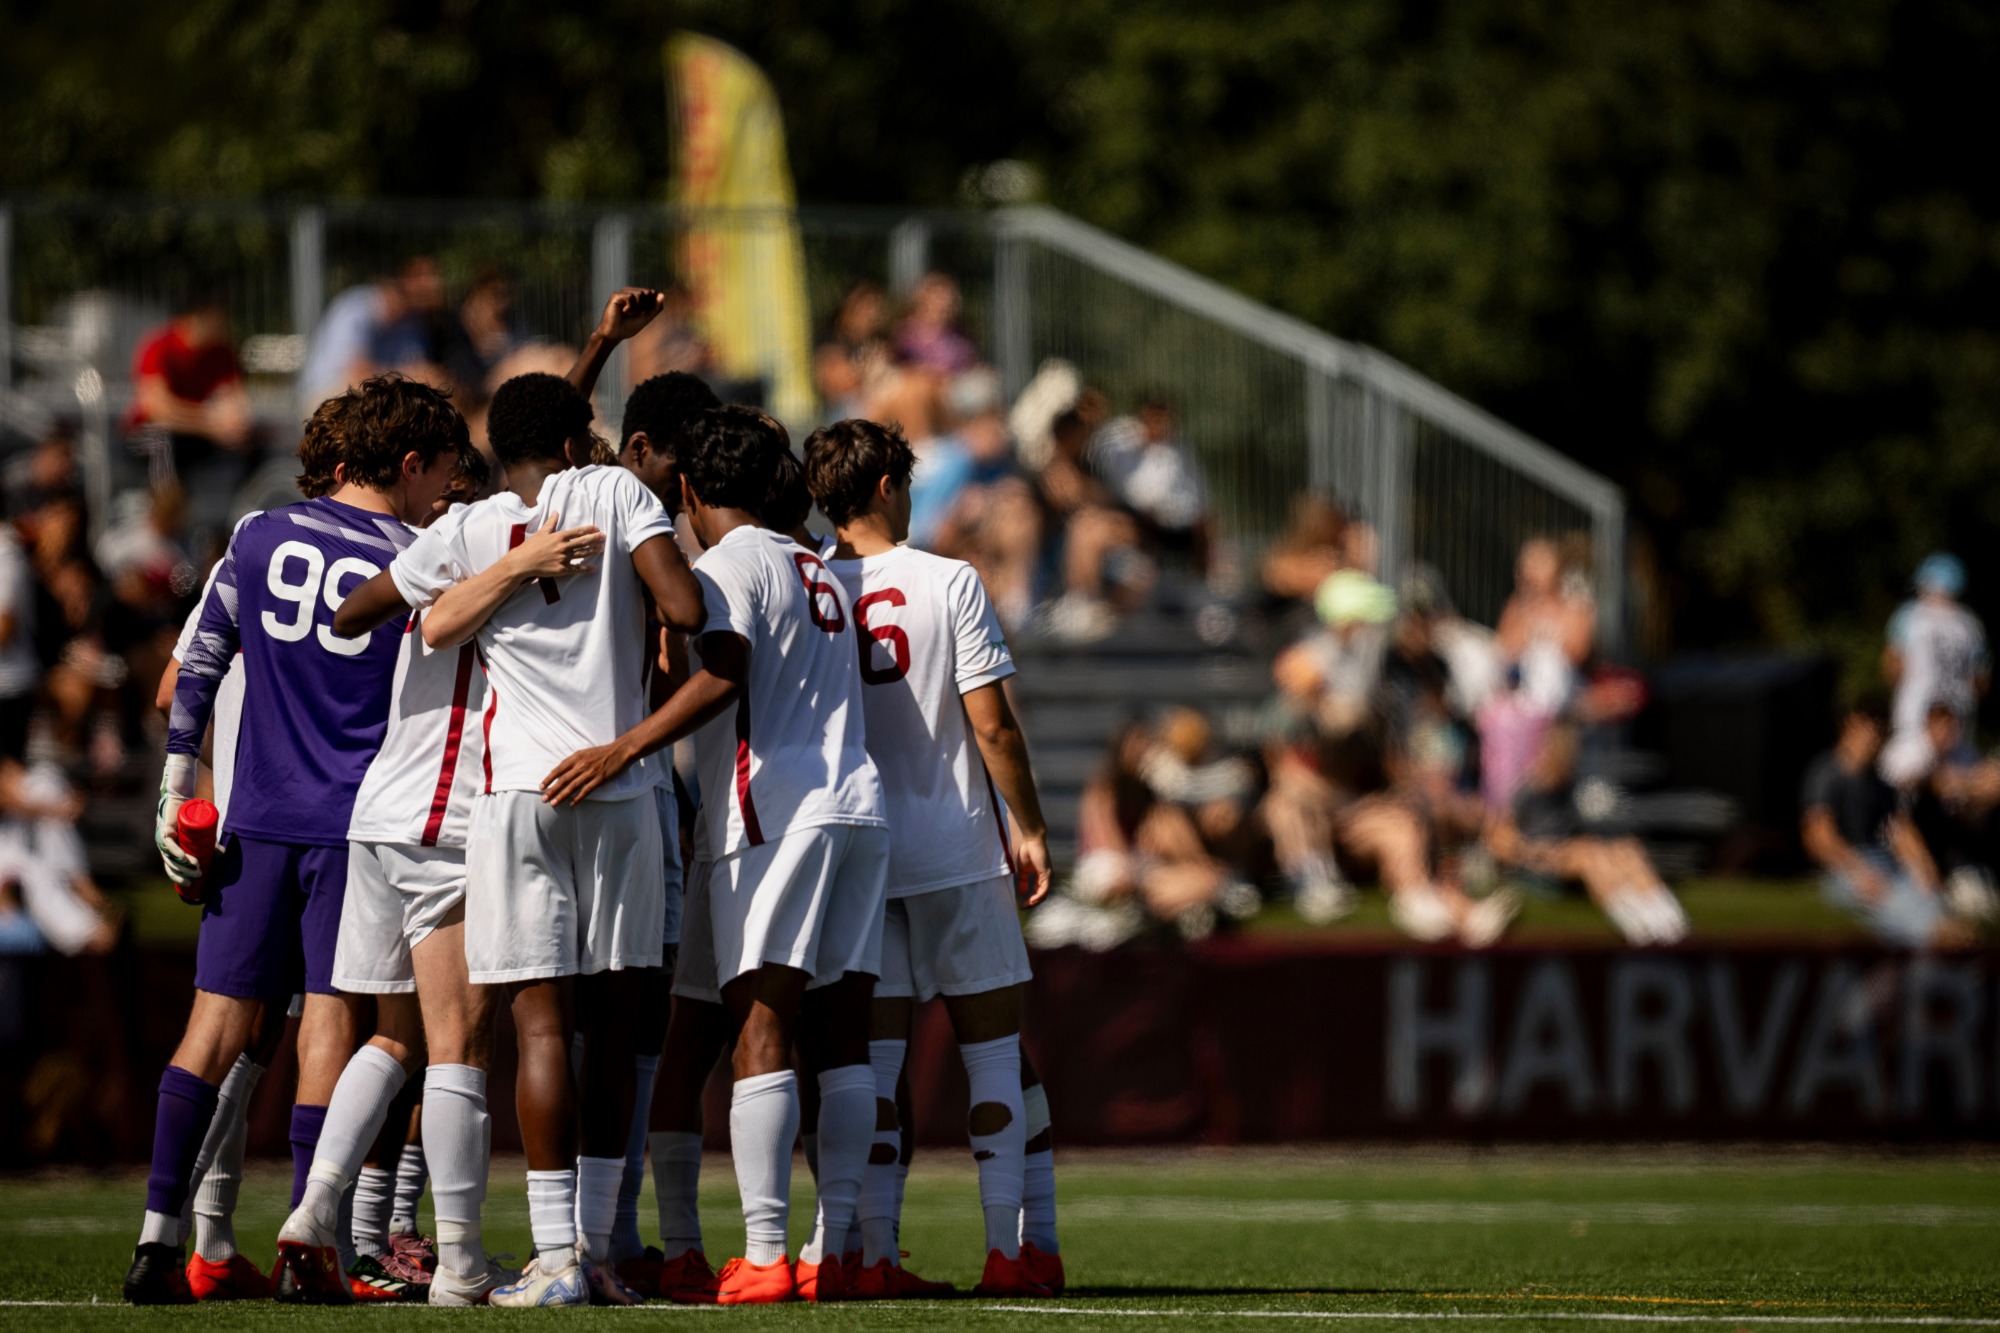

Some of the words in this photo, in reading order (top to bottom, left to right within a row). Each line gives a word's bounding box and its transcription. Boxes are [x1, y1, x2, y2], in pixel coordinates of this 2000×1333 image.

[261, 540, 382, 656] 99
[793, 552, 845, 633] 6
[852, 587, 911, 686] 6
[1384, 955, 2000, 1118] HARVAR
